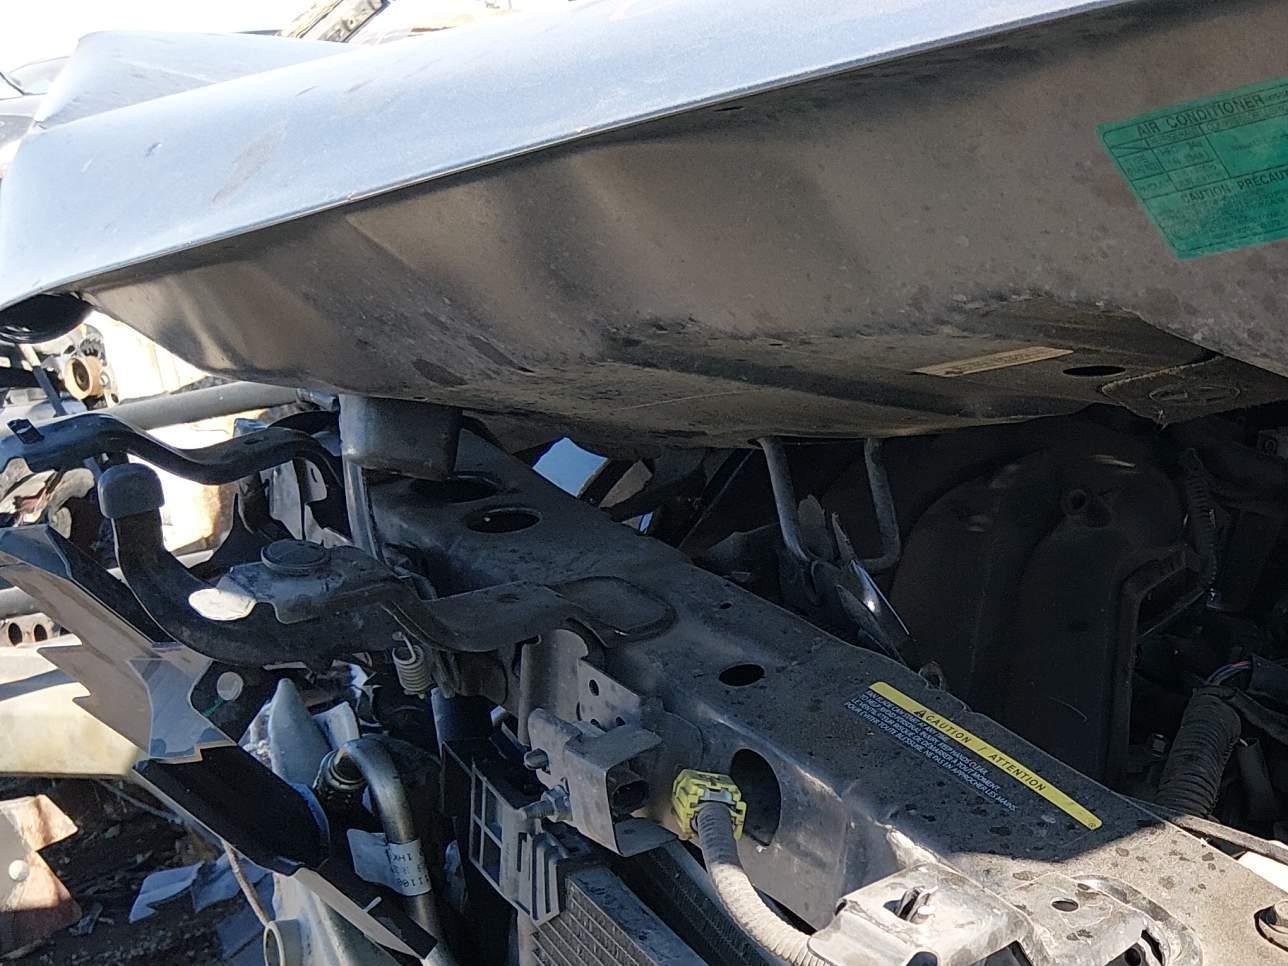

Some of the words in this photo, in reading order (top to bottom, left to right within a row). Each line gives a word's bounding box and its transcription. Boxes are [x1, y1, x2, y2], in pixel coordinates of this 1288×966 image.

[1137, 122, 1160, 137] AIR
[1166, 95, 1265, 130] CONDITIONER
[1182, 179, 1231, 203] CAUTION
[926, 715, 972, 743] CAUTION
[988, 752, 1046, 792] ATTENTION
